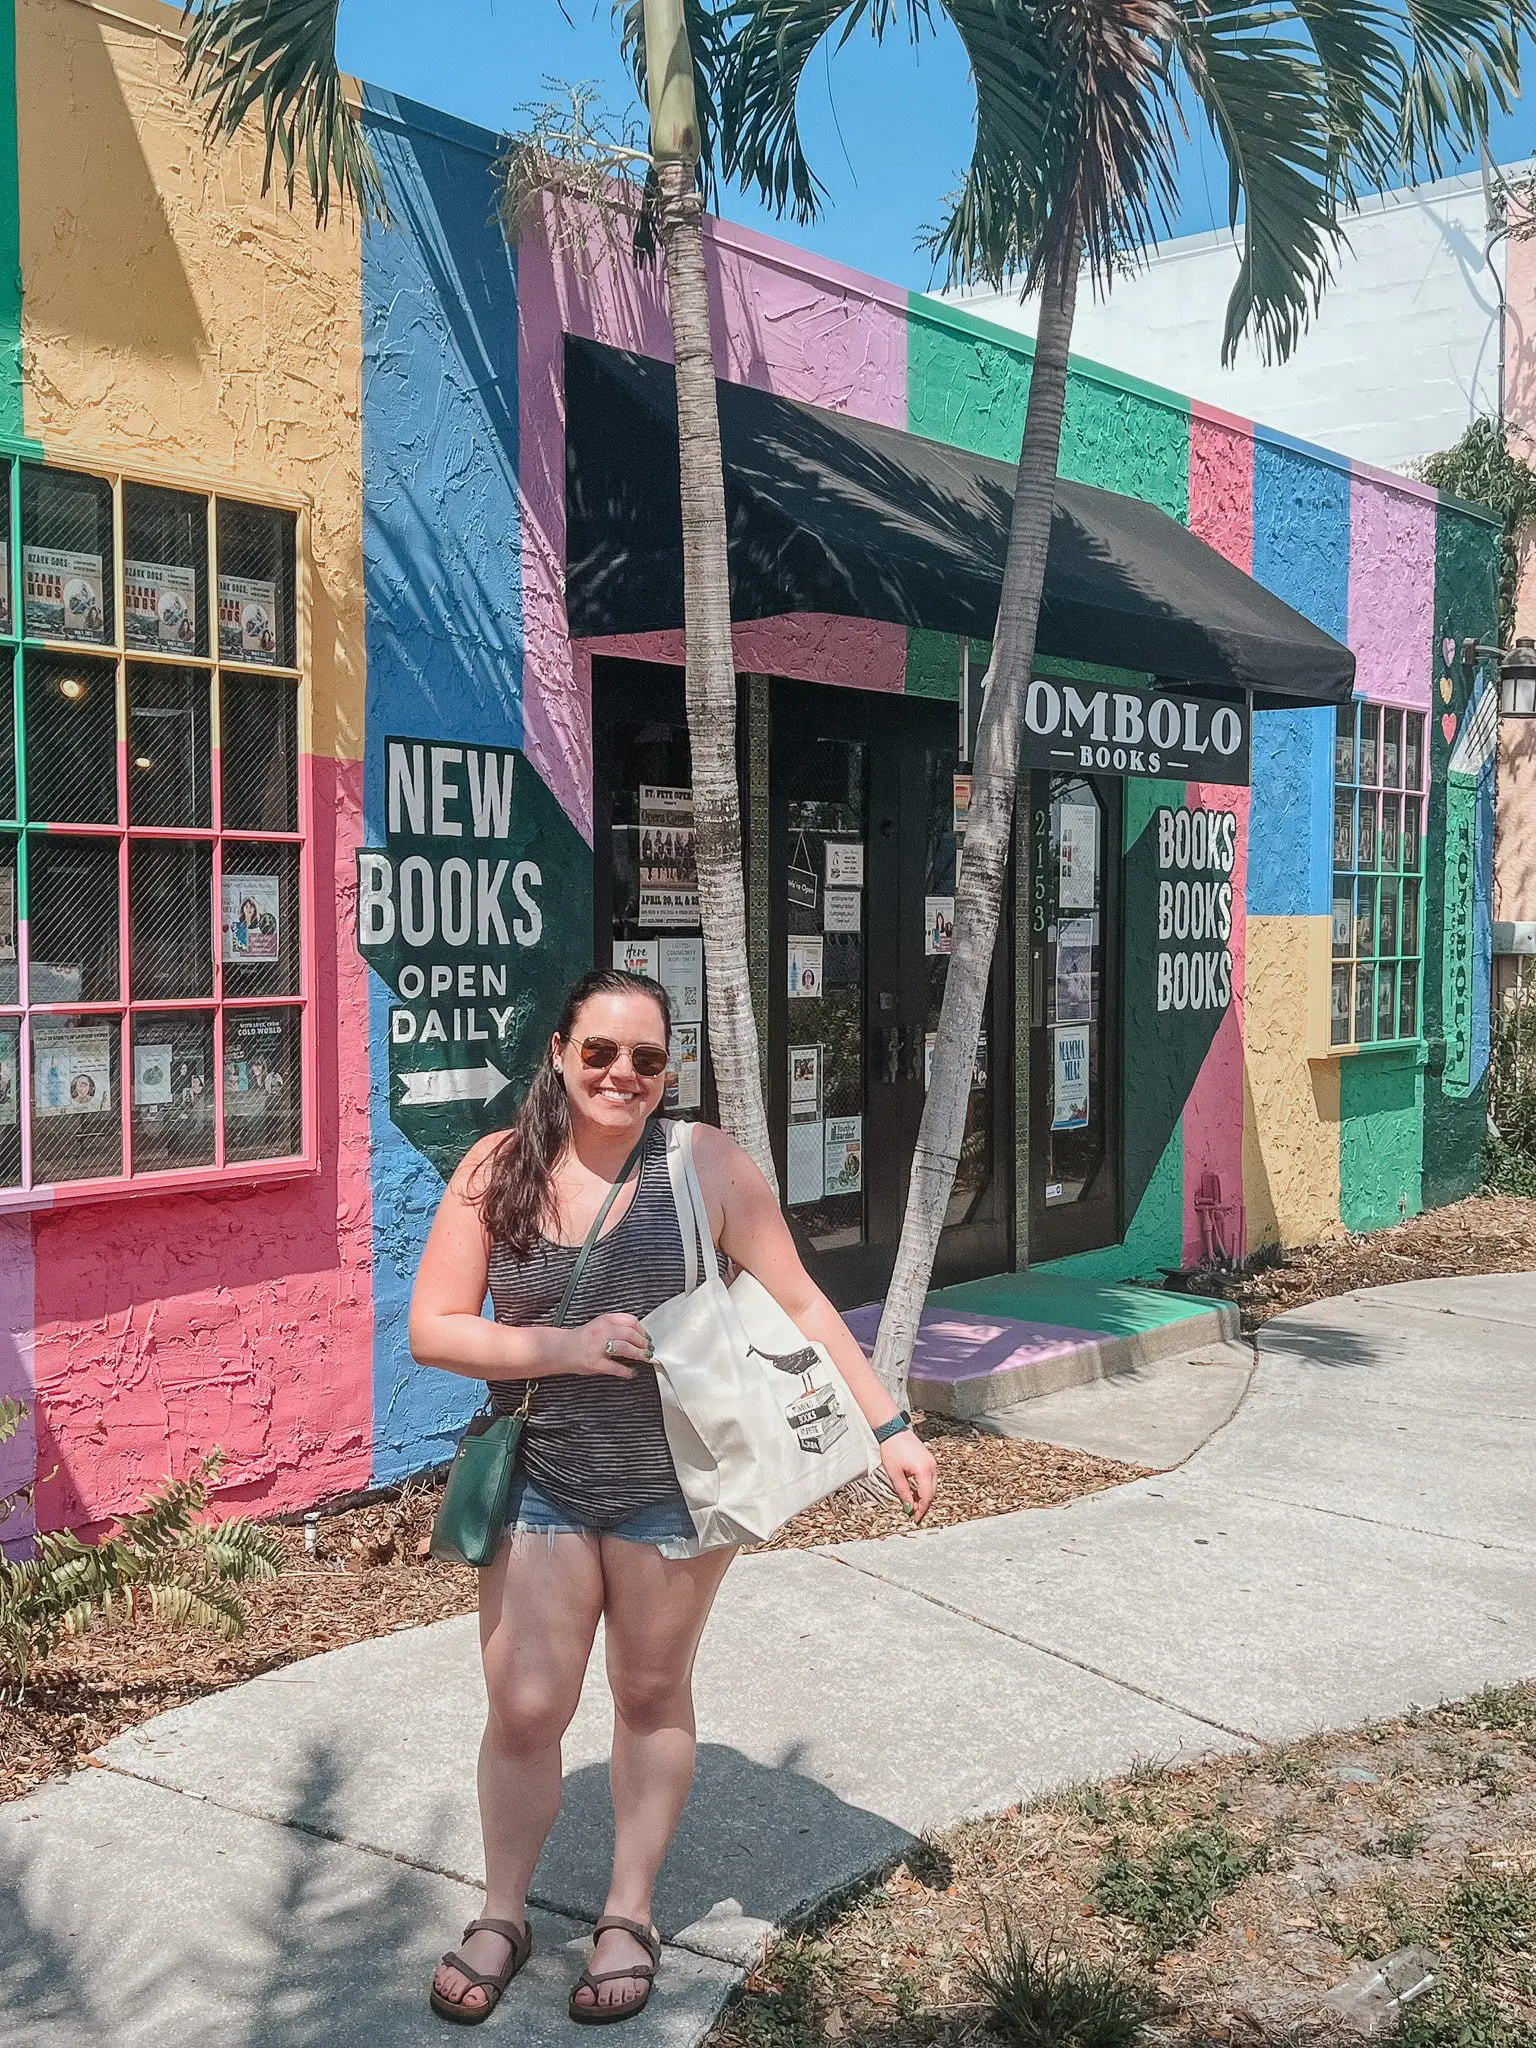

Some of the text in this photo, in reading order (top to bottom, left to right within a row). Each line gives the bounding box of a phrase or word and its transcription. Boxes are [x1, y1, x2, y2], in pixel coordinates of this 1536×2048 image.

[28, 553, 49, 565] OZARK
[28, 571, 61, 586] OZARK
[28, 582, 61, 599] DOGS
[220, 608, 240, 623] OGS
[981, 672, 1242, 755] OMBOLO
[1079, 744, 1161, 774] BOOKS
[387, 742, 515, 839] NEW
[1159, 809, 1236, 873] BOOKS
[358, 852, 543, 947] BOOKS
[640, 895, 662, 905] APRIL
[1158, 880, 1232, 941] BOOKS
[625, 943, 648, 960] Here
[1454, 818, 1469, 1063] TOMBOLO
[398, 964, 507, 999] OPEN
[1157, 950, 1232, 1012] BOOKS
[238, 1026, 282, 1037] COLD WORLD
[391, 1005, 515, 1044] DAILY
[1058, 1039, 1085, 1060] MAMMA
[797, 1410, 817, 1425] BOOKS
